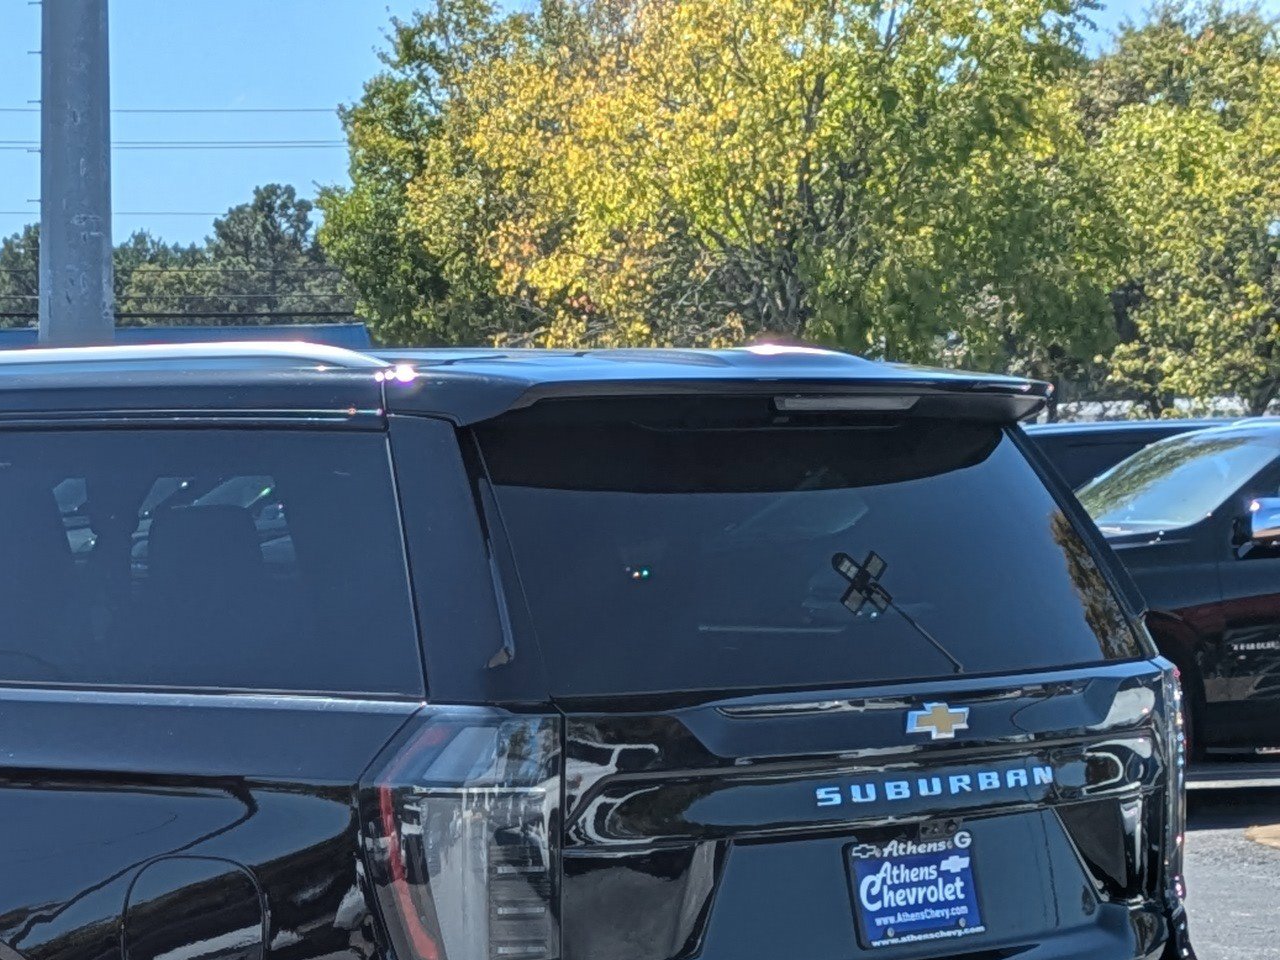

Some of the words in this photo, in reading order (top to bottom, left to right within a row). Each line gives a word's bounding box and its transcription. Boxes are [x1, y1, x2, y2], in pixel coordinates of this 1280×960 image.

[816, 766, 1054, 806] SUBURBAN
[882, 840, 946, 857] Athens
[877, 861, 938, 885] Athens
[860, 875, 965, 911] Chevrolet
[875, 906, 968, 926] www.AthensChevy.com
[871, 926, 986, 947] www.athenschevy.com
